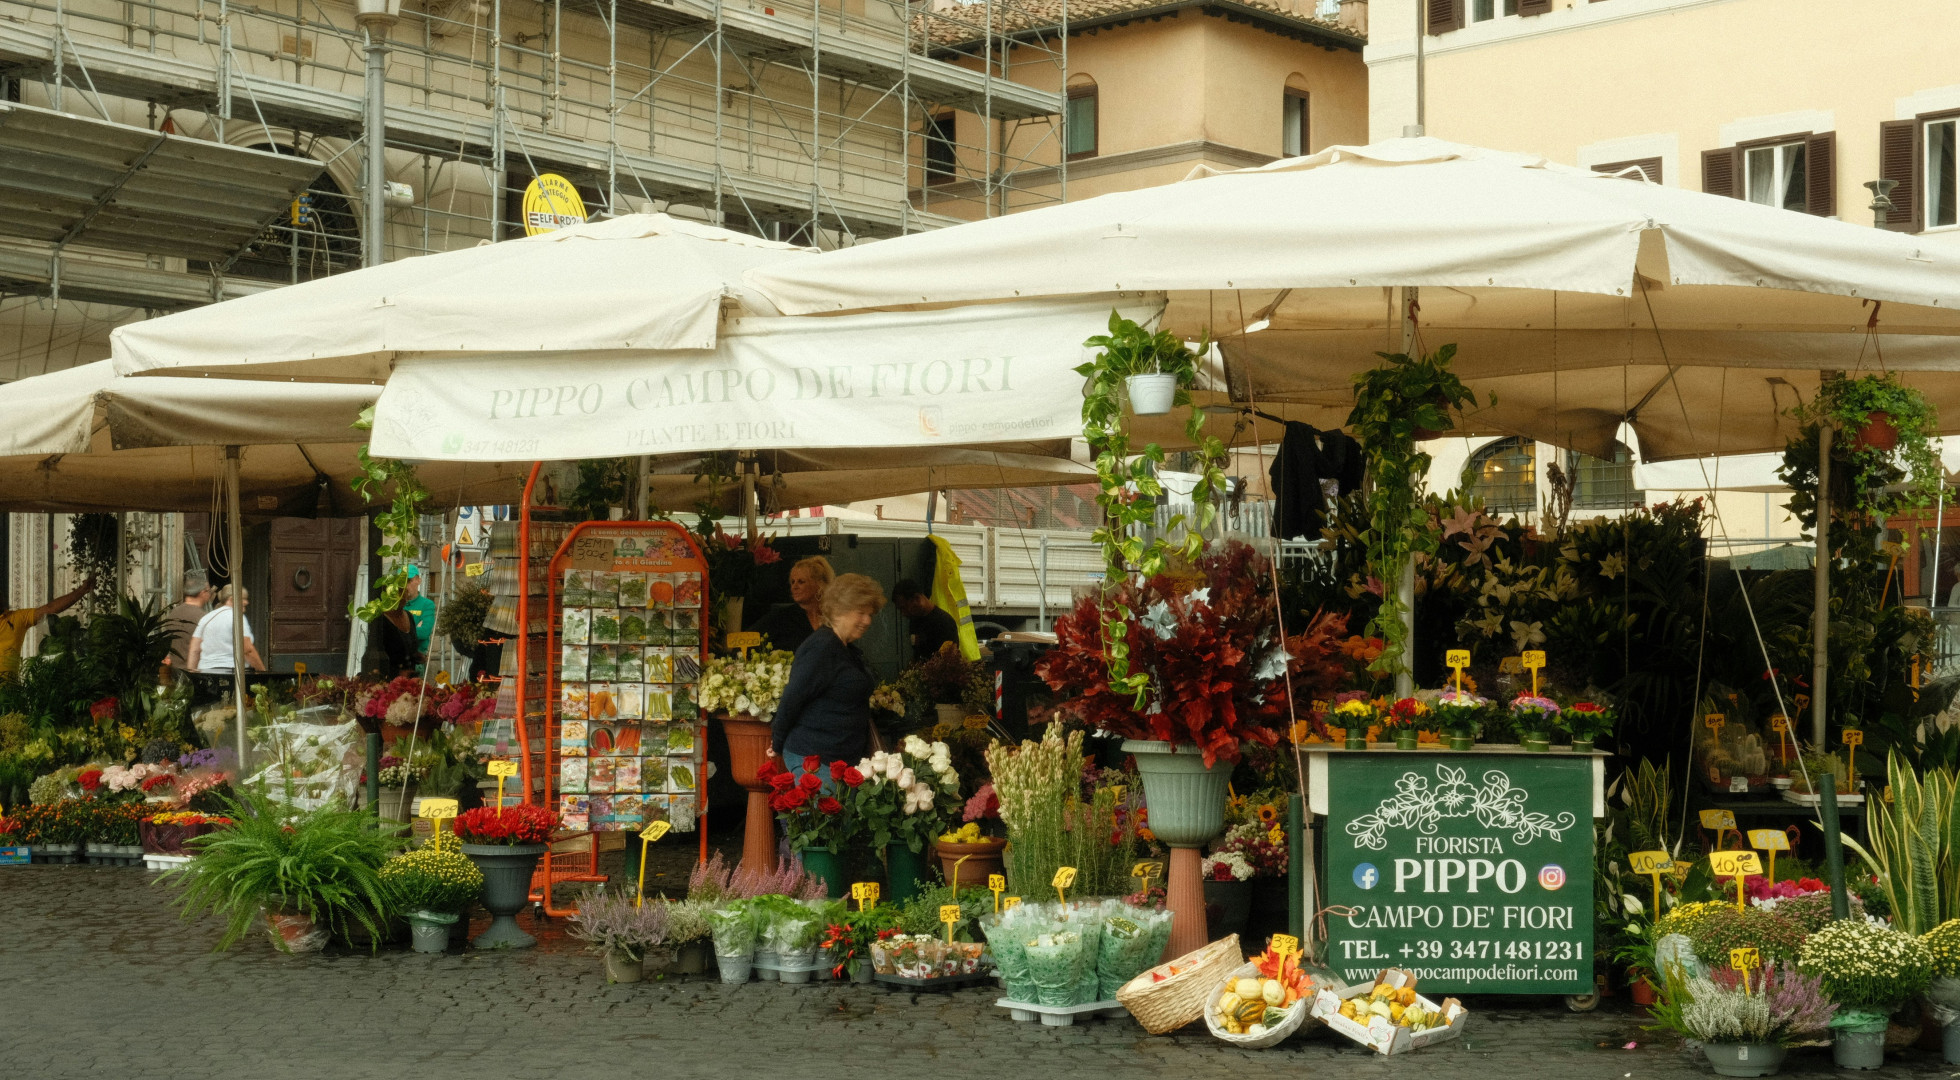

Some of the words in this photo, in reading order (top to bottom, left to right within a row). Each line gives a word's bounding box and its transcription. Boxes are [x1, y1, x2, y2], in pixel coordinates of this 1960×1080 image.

[488, 383, 604, 421] PIPPO
[625, 367, 777, 411] CAMPO
[790, 364, 855, 402] DE
[868, 355, 1017, 398] FIORI
[626, 424, 706, 447] PIANTE
[715, 422, 730, 442] E
[736, 421, 797, 441] FIORI
[575, 538, 606, 549] SEMI
[1416, 836, 1504, 855] FIORISTA
[1393, 858, 1527, 894] PIPPO
[1348, 905, 1444, 929] CAMPO
[1452, 905, 1495, 929] DE'
[1503, 905, 1574, 931] FIORI
[1339, 940, 1390, 960] TEL.
[1398, 940, 1443, 959] +39
[1449, 940, 1583, 960] 3471481231
